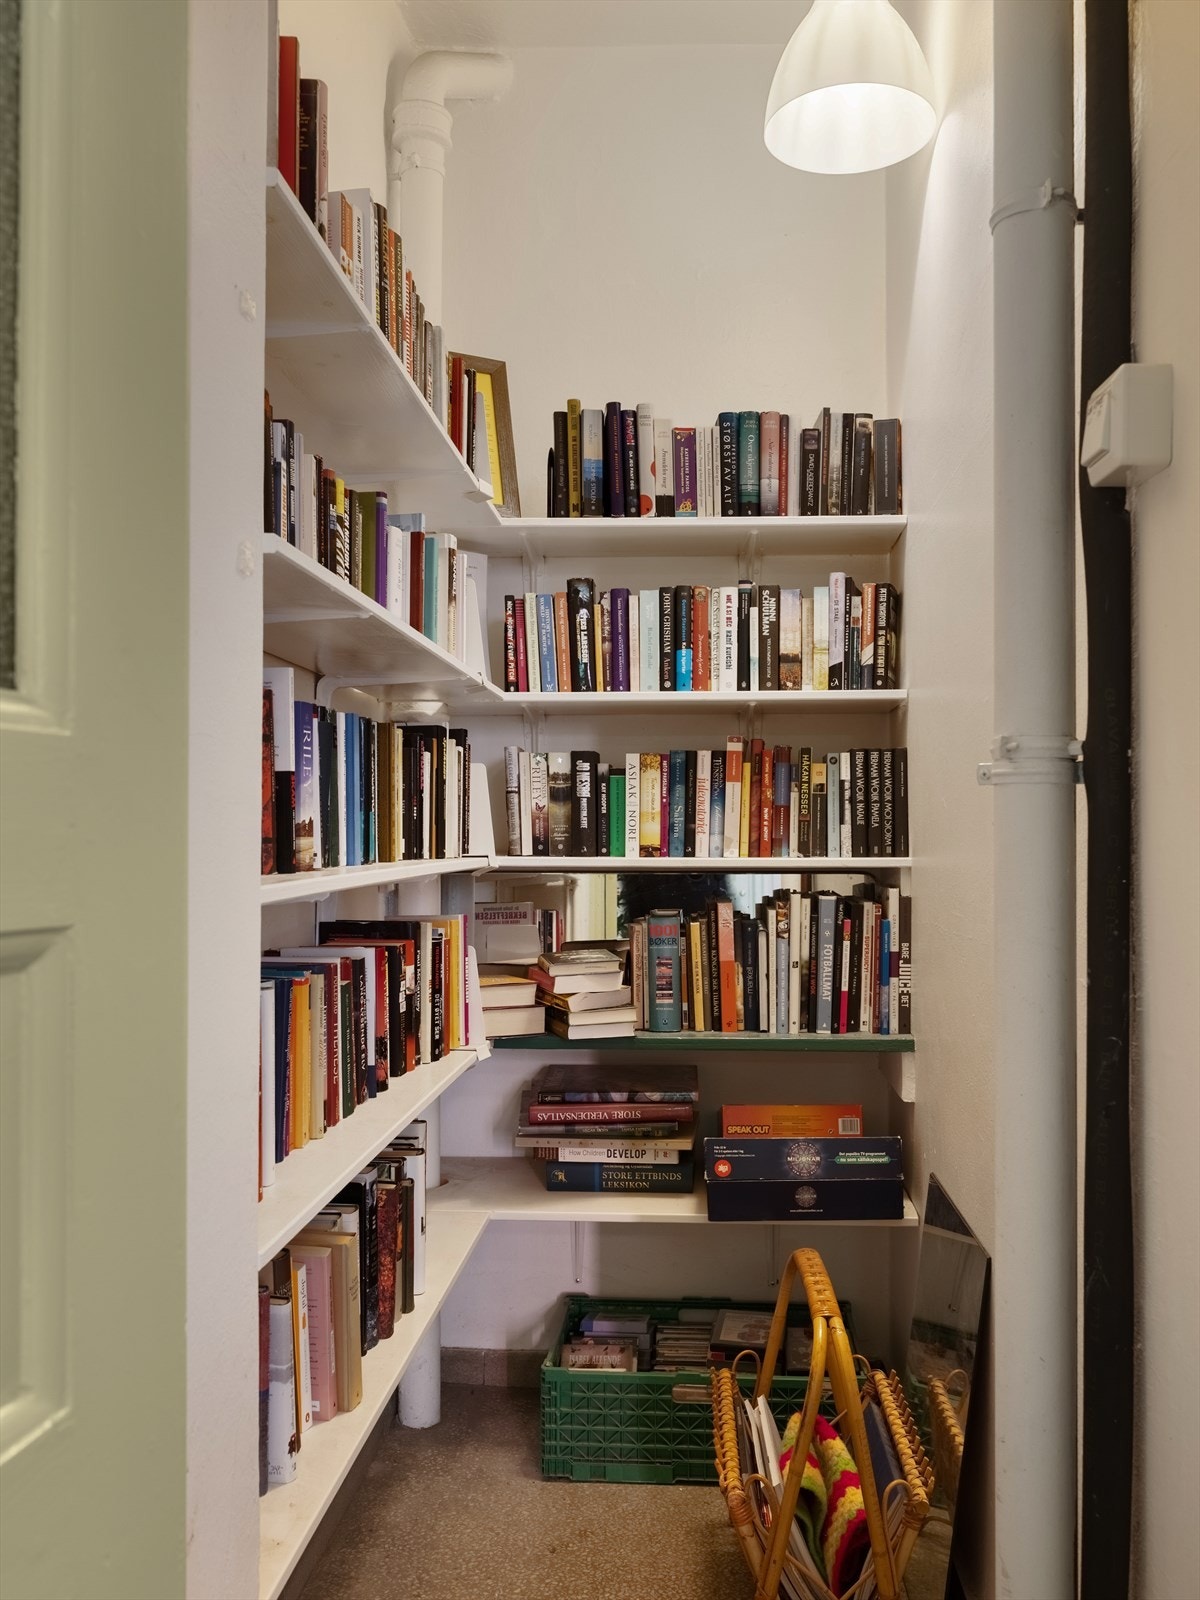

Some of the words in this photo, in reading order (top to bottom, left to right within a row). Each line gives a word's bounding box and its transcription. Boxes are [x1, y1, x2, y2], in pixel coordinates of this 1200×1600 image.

[723, 422, 731, 463] STØRST
[724, 467, 731, 481] AV
[724, 485, 732, 504] ALT
[662, 592, 671, 614] JOHN
[663, 615, 671, 653] GRISHAM
[580, 631, 588, 663] LARSSON
[663, 657, 671, 680] Anken
[303, 729, 312, 791] RILEY
[576, 760, 590, 771] JO
[801, 754, 810, 781] HÅKAN
[855, 751, 865, 777] HERMAN
[870, 751, 879, 777] HERMAN
[883, 751, 892, 777] HERMAN
[532, 767, 541, 802] RILEY
[576, 772, 591, 797] NESBØ
[628, 763, 637, 799] ASLAK
[855, 778, 865, 801] WOUK
[870, 778, 879, 801] WOUK
[884, 778, 892, 801] WOUK
[801, 783, 809, 815] NESSER
[628, 810, 637, 842] NORE
[673, 805, 683, 838] Sabina
[871, 803, 880, 828] PAMELA
[901, 942, 909, 959] BARE
[822, 944, 833, 1002] FOTBALLMAT
[899, 959, 911, 994] JUICE
[901, 995, 909, 1008] DET
[537, 1111, 609, 1121] VERDENSATLAS
[612, 1110, 641, 1119] STORE
[727, 1125, 752, 1134] SPEAK
[752, 1125, 770, 1134] OUT
[606, 1149, 647, 1159] DEVELOP
[602, 1171, 633, 1180] STORE
[635, 1172, 682, 1181] ETTBINDS
[602, 1181, 650, 1189] LEKSIKON
